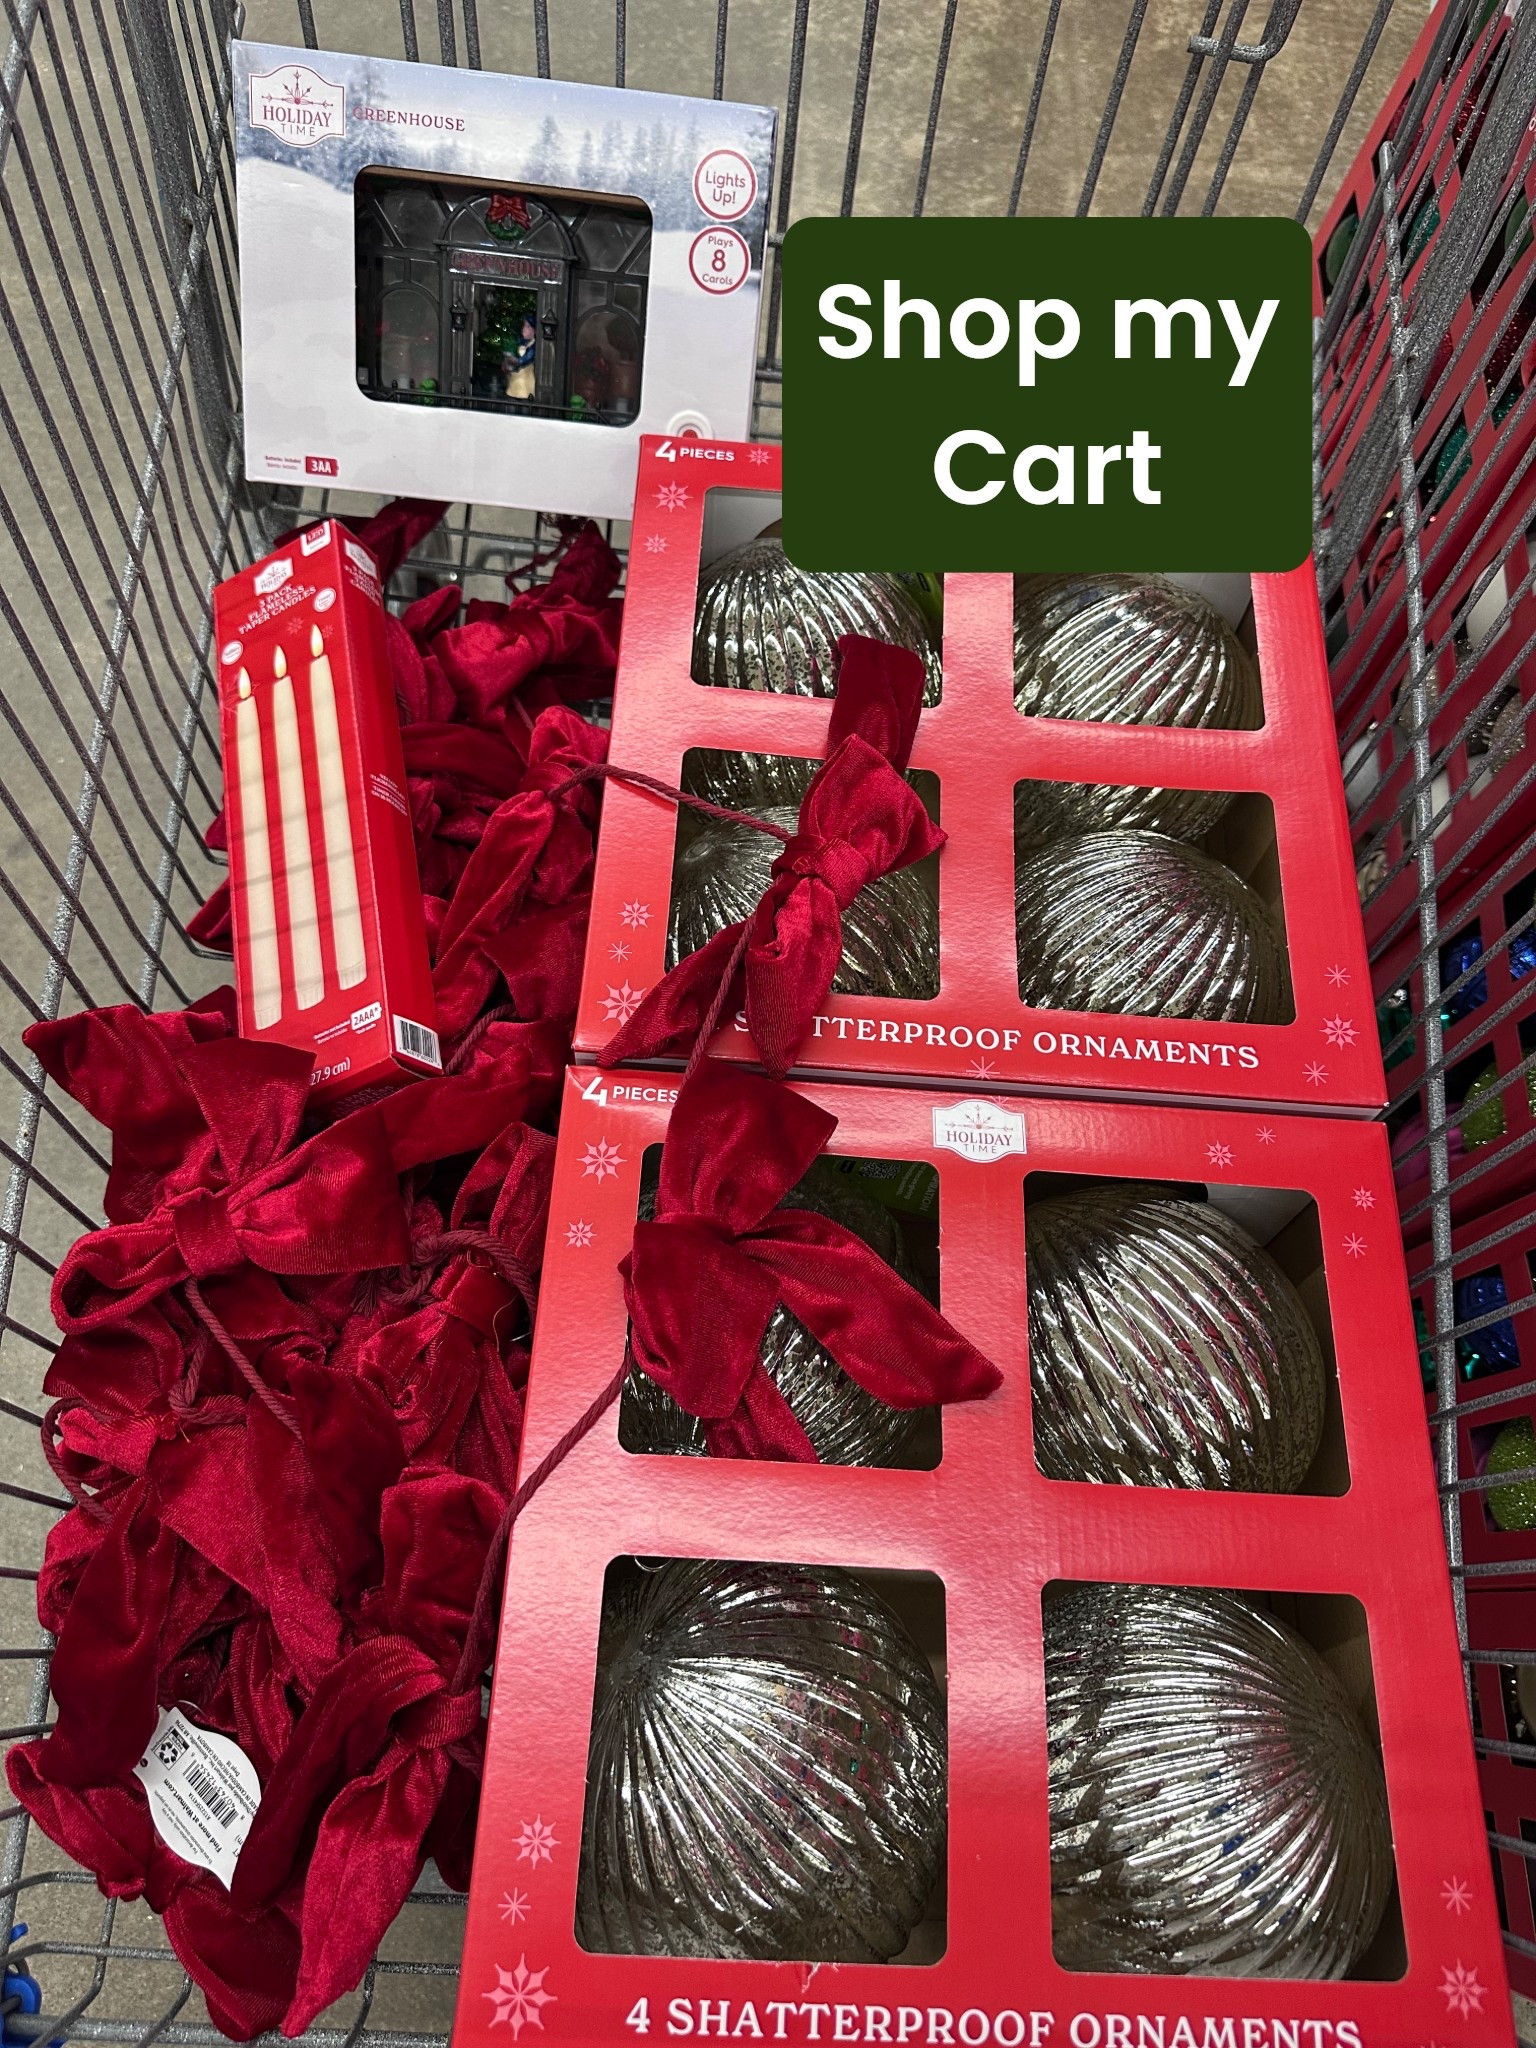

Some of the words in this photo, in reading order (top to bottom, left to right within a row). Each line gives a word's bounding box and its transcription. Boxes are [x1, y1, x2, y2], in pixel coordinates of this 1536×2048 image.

[263, 106, 332, 127] HOLIDAY
[352, 106, 465, 132] GREENHOUSE
[280, 123, 316, 137] TIME
[705, 170, 746, 188] Lights
[712, 189, 736, 206] Up!
[708, 235, 734, 249] Plays
[712, 249, 726, 272] 8
[702, 273, 733, 286] Carols
[655, 440, 676, 463] 4
[680, 446, 735, 462] PIECES
[311, 459, 332, 474] 3AA
[248, 585, 305, 621] FLAMELESS
[266, 584, 293, 605] PACK
[238, 612, 271, 635] TAPER
[270, 587, 317, 618] CANDLES
[733, 1011, 1021, 1051] STTERPROOF
[1033, 1030, 1260, 1069] ORNAMENTS
[332, 1056, 351, 1076] cm)
[582, 1076, 608, 1107] 4
[613, 1085, 679, 1103] PIECES
[946, 1130, 1012, 1146] HOLIDAY
[963, 1143, 998, 1154] TIME
[213, 1766, 229, 1784] Walmart
[162, 1777, 195, 1818] Walmart.com
[192, 1815, 199, 1823] at
[197, 1822, 211, 1838] more
[208, 1837, 222, 1852] Find
[625, 1996, 651, 2033] 4
[666, 1997, 1055, 2048] SHATTERPROOF
[1069, 2012, 1362, 2048] ORNAMENTS
